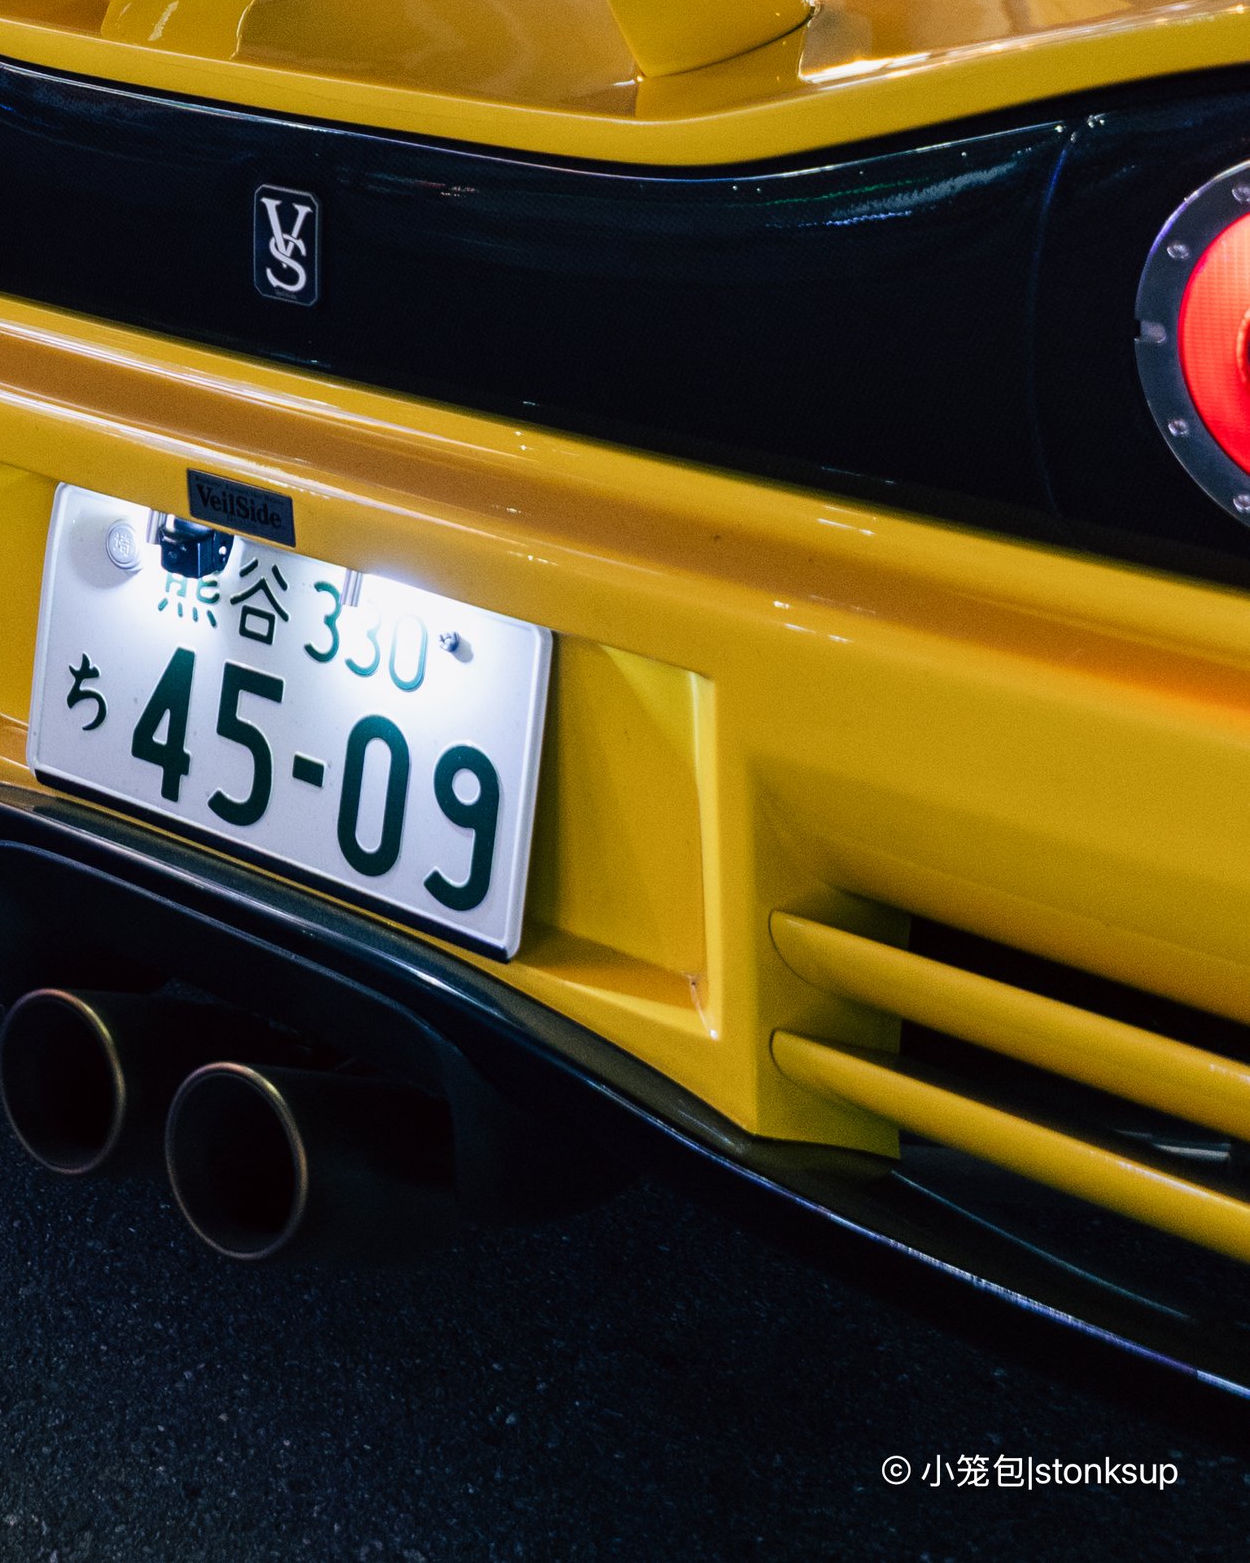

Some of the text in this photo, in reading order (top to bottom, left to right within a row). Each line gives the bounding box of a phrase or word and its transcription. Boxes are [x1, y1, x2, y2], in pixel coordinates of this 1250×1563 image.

[195, 483, 283, 529] VeilSide
[303, 580, 429, 692] 330
[66, 646, 501, 912] ち 45-09
